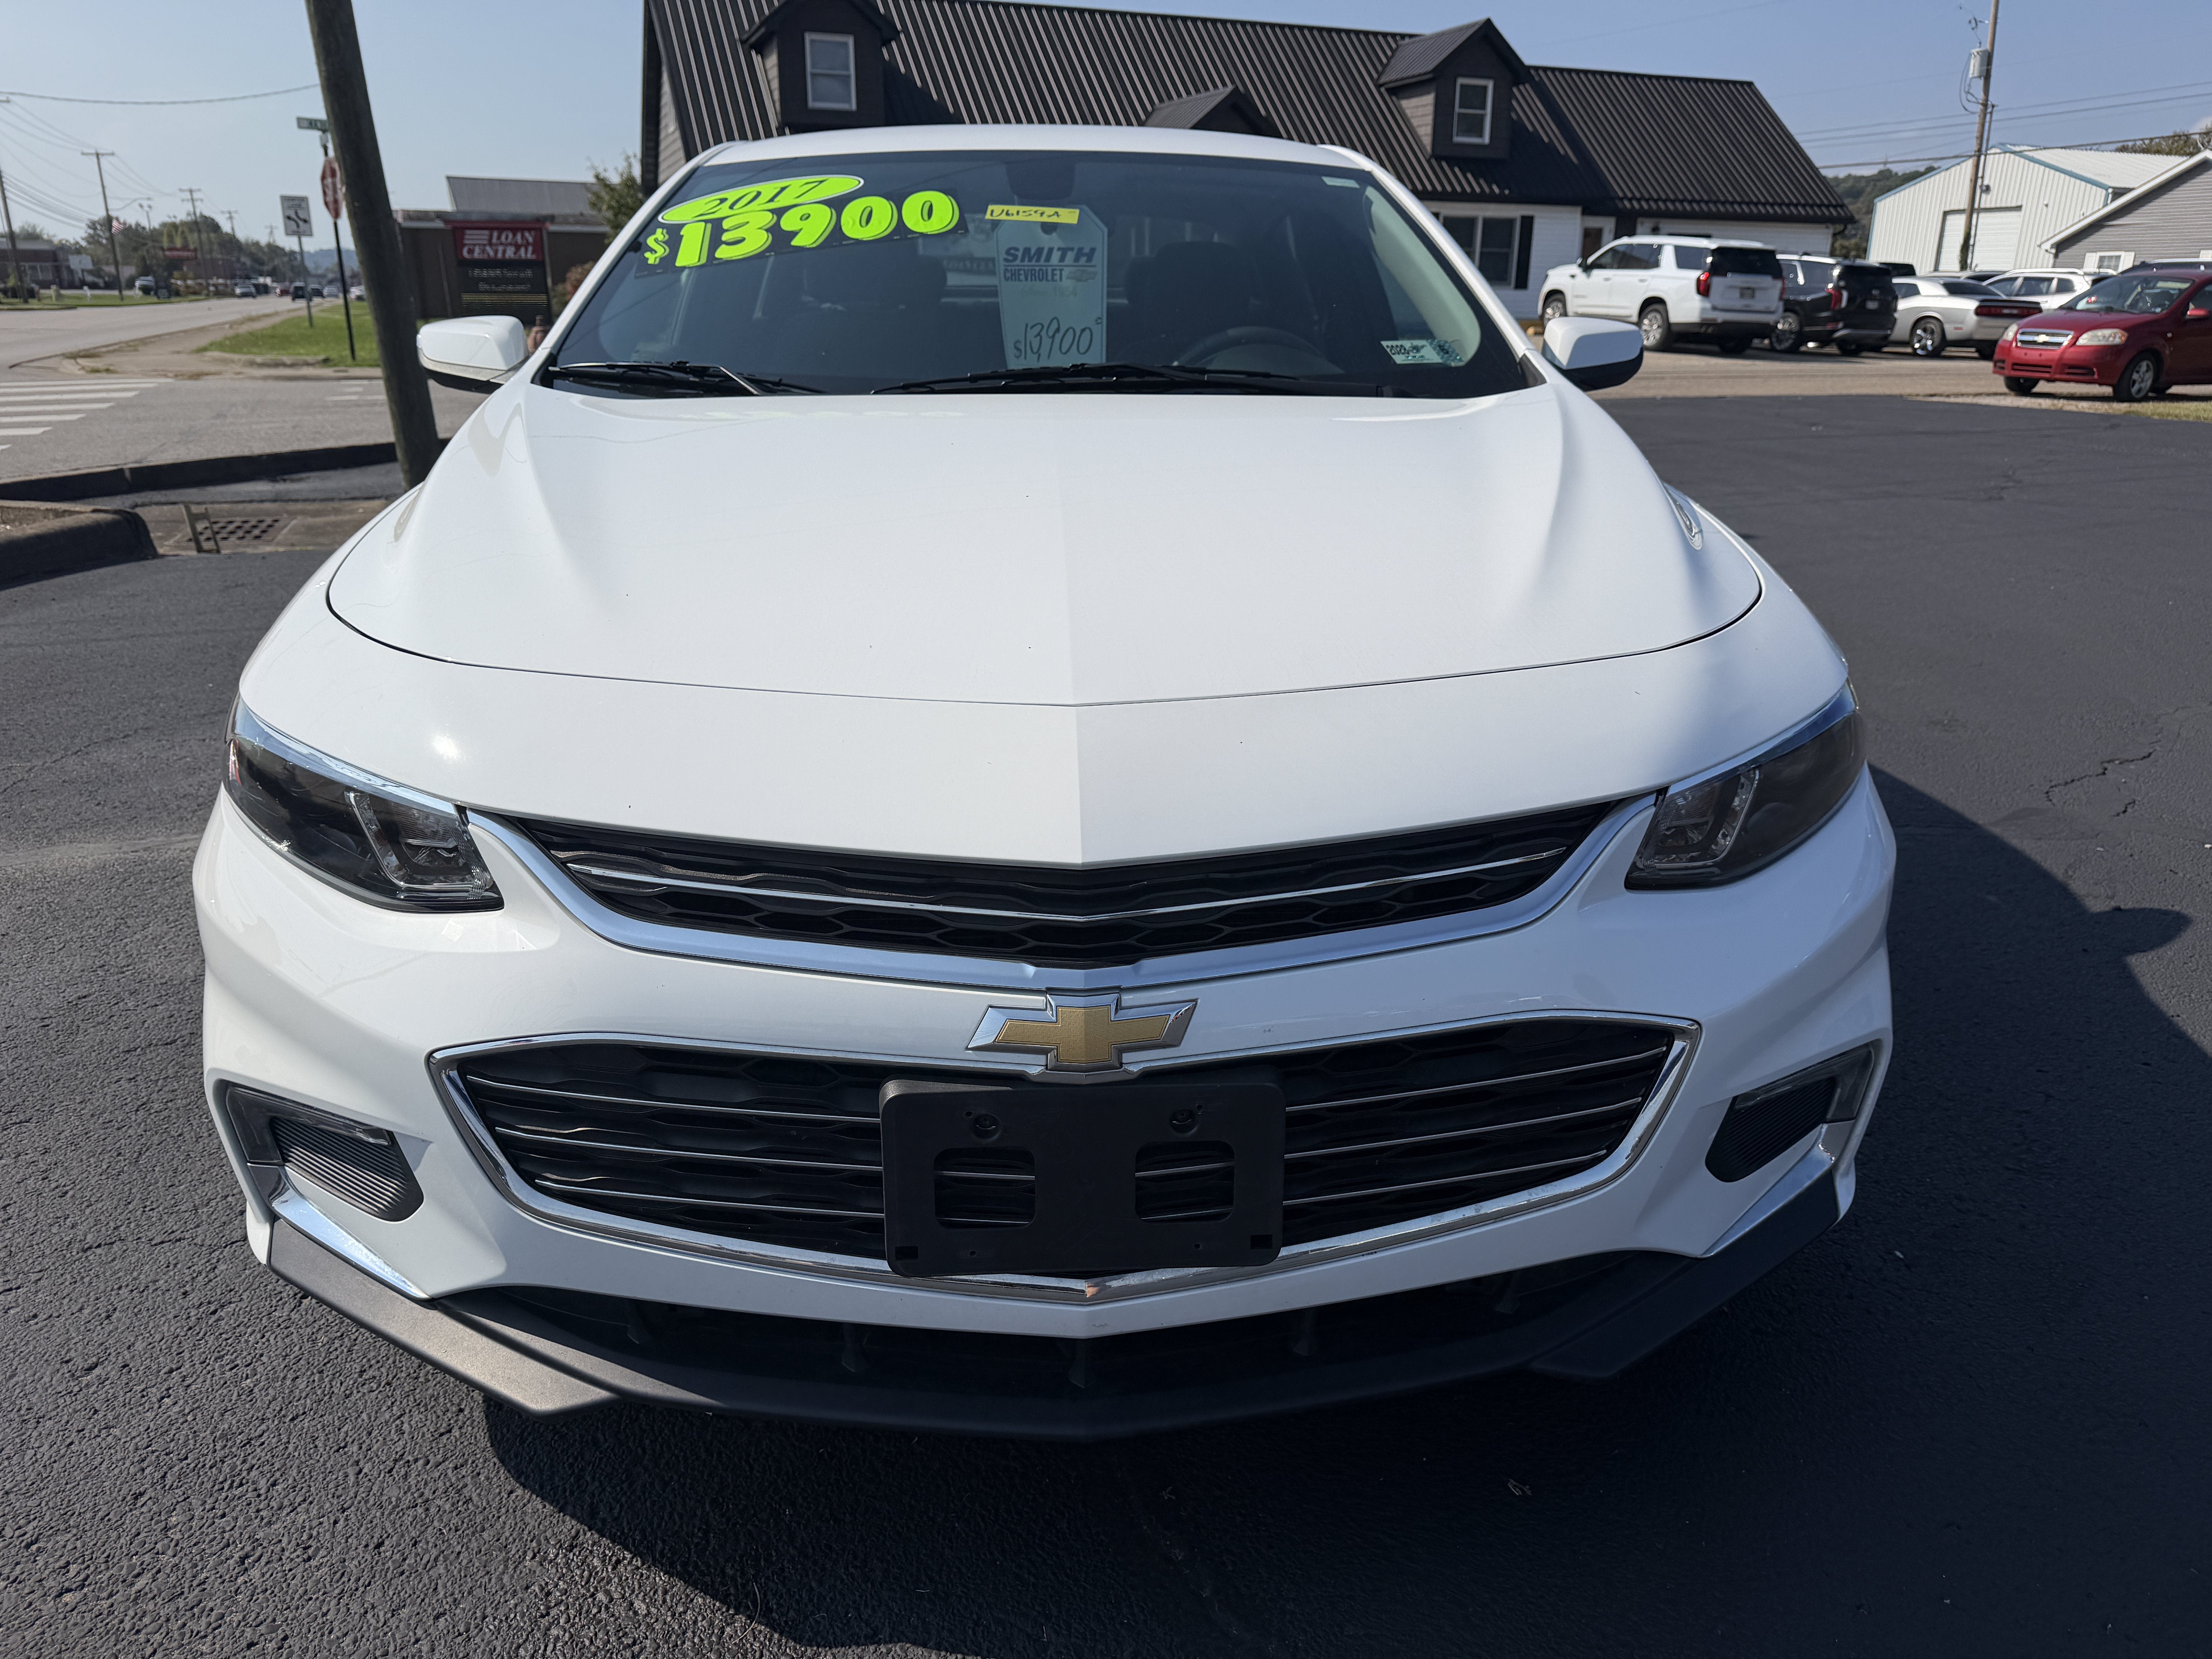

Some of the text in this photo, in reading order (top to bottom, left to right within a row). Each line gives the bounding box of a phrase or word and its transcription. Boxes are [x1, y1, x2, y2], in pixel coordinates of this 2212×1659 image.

[692, 179, 829, 218] 2017
[491, 230, 535, 244] LOAN
[462, 244, 536, 259] CENTRAL
[1003, 247, 1097, 263] SMITH
[1004, 268, 1065, 282] CHEVROLET
